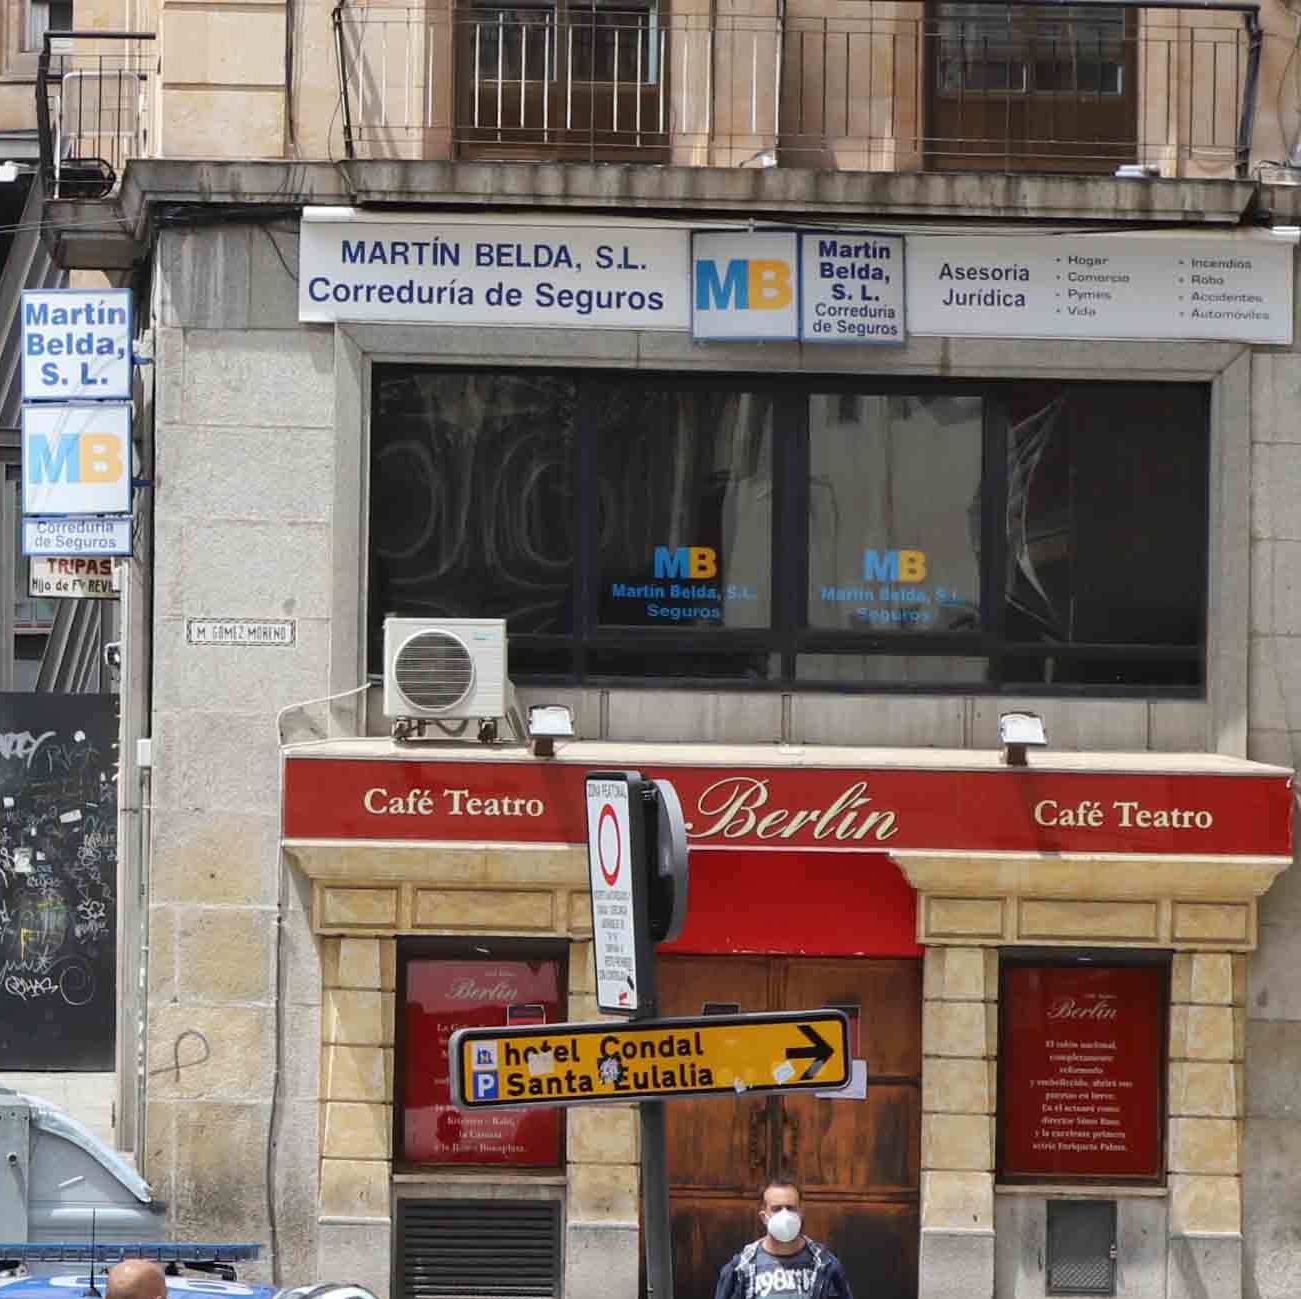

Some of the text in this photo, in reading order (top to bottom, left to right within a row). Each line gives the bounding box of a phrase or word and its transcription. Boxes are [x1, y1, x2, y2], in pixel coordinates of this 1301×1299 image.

[341, 237, 646, 272] MARTÍN BELDA, S.L.
[693, 259, 792, 310] MB
[820, 262, 890, 284] Belda,
[308, 277, 664, 314] Correduría de Seguros
[831, 283, 880, 301] S. L.
[942, 288, 1026, 307] Jurídica
[26, 299, 126, 325] Martín
[813, 320, 898, 336] de Seguros
[27, 332, 125, 360] Belda,
[41, 362, 108, 386] S. L.
[28, 431, 125, 484] MB
[55, 536, 117, 551] Seguros
[46, 558, 112, 576] TRIPAS
[654, 545, 717, 579] MB
[863, 548, 928, 583] MB
[646, 604, 721, 620] Seguros
[363, 787, 545, 817] Café Teatro
[1033, 799, 1214, 828] Café Teatro
[600, 1031, 704, 1063] Condal
[507, 1063, 714, 1097] Santa Eulalia
